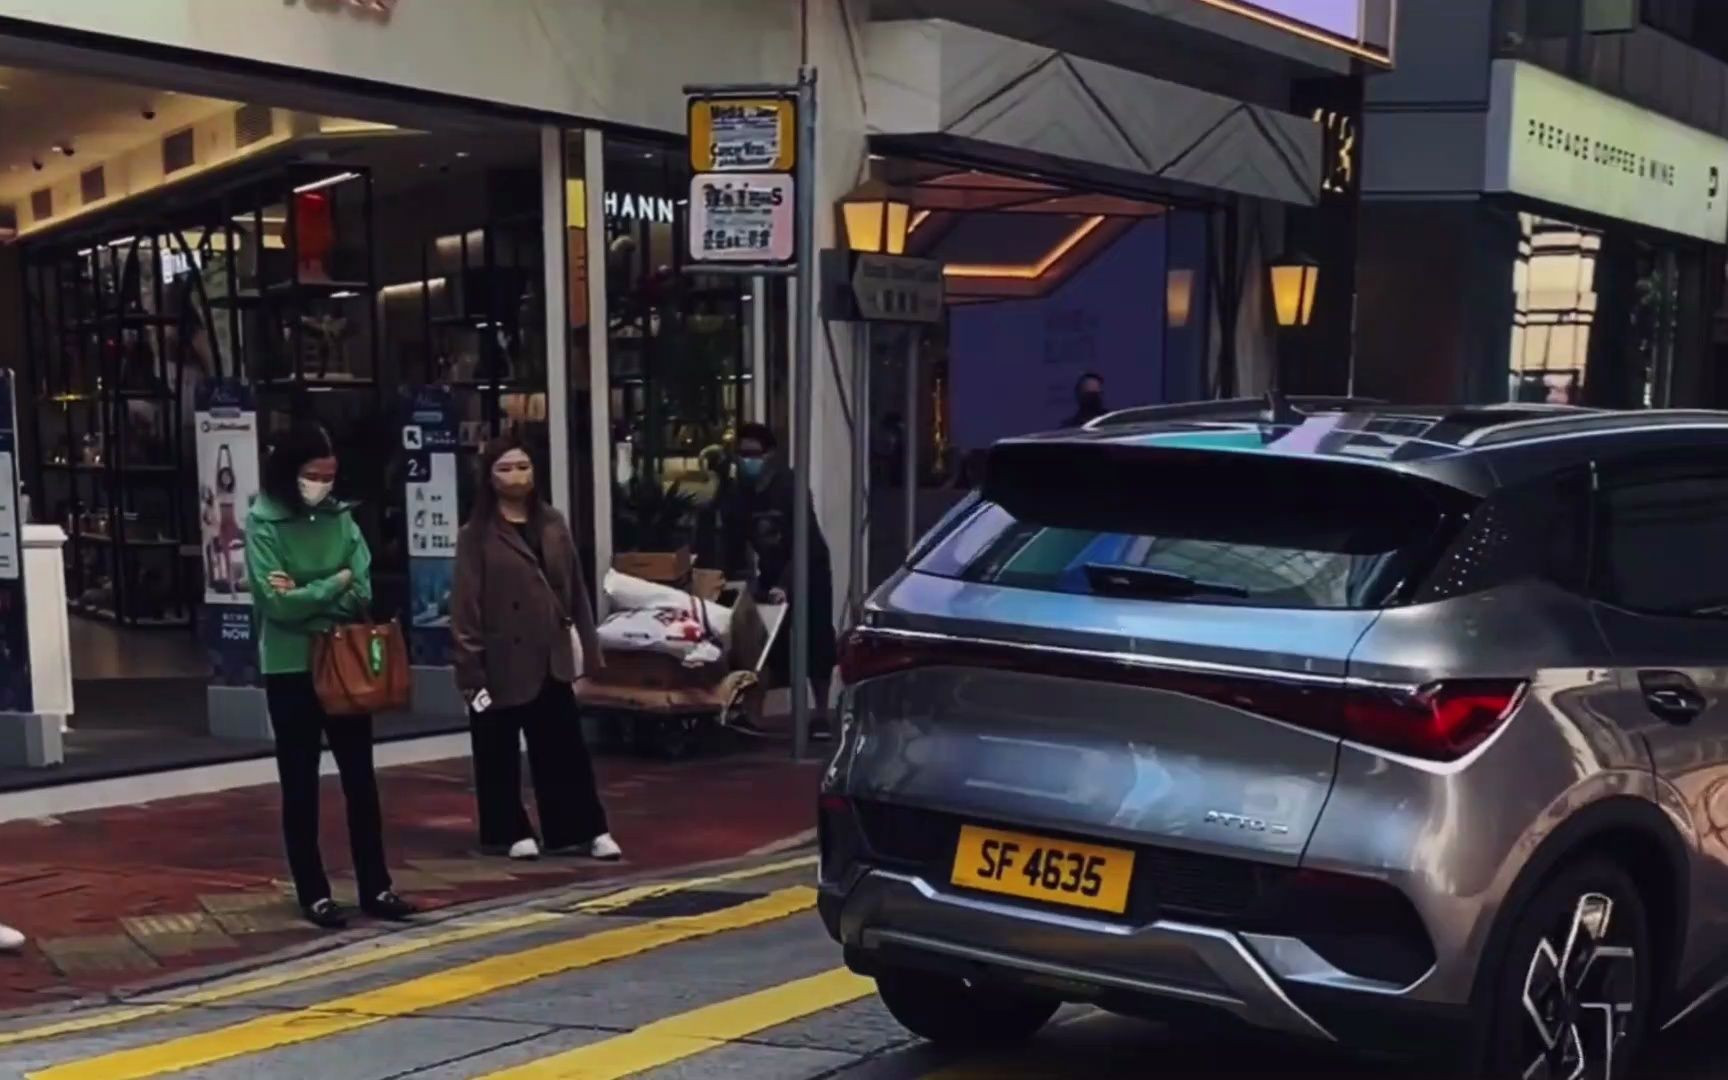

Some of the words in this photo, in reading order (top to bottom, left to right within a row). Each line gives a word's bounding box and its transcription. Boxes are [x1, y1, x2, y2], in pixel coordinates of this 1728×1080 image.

[1528, 118, 1589, 160] PREFACE
[1594, 140, 1636, 174] COFFEE
[1650, 159, 1674, 187] WINE
[1204, 809, 1266, 832] ATTO
[977, 839, 1019, 881] SF
[1022, 848, 1106, 897] 4635
